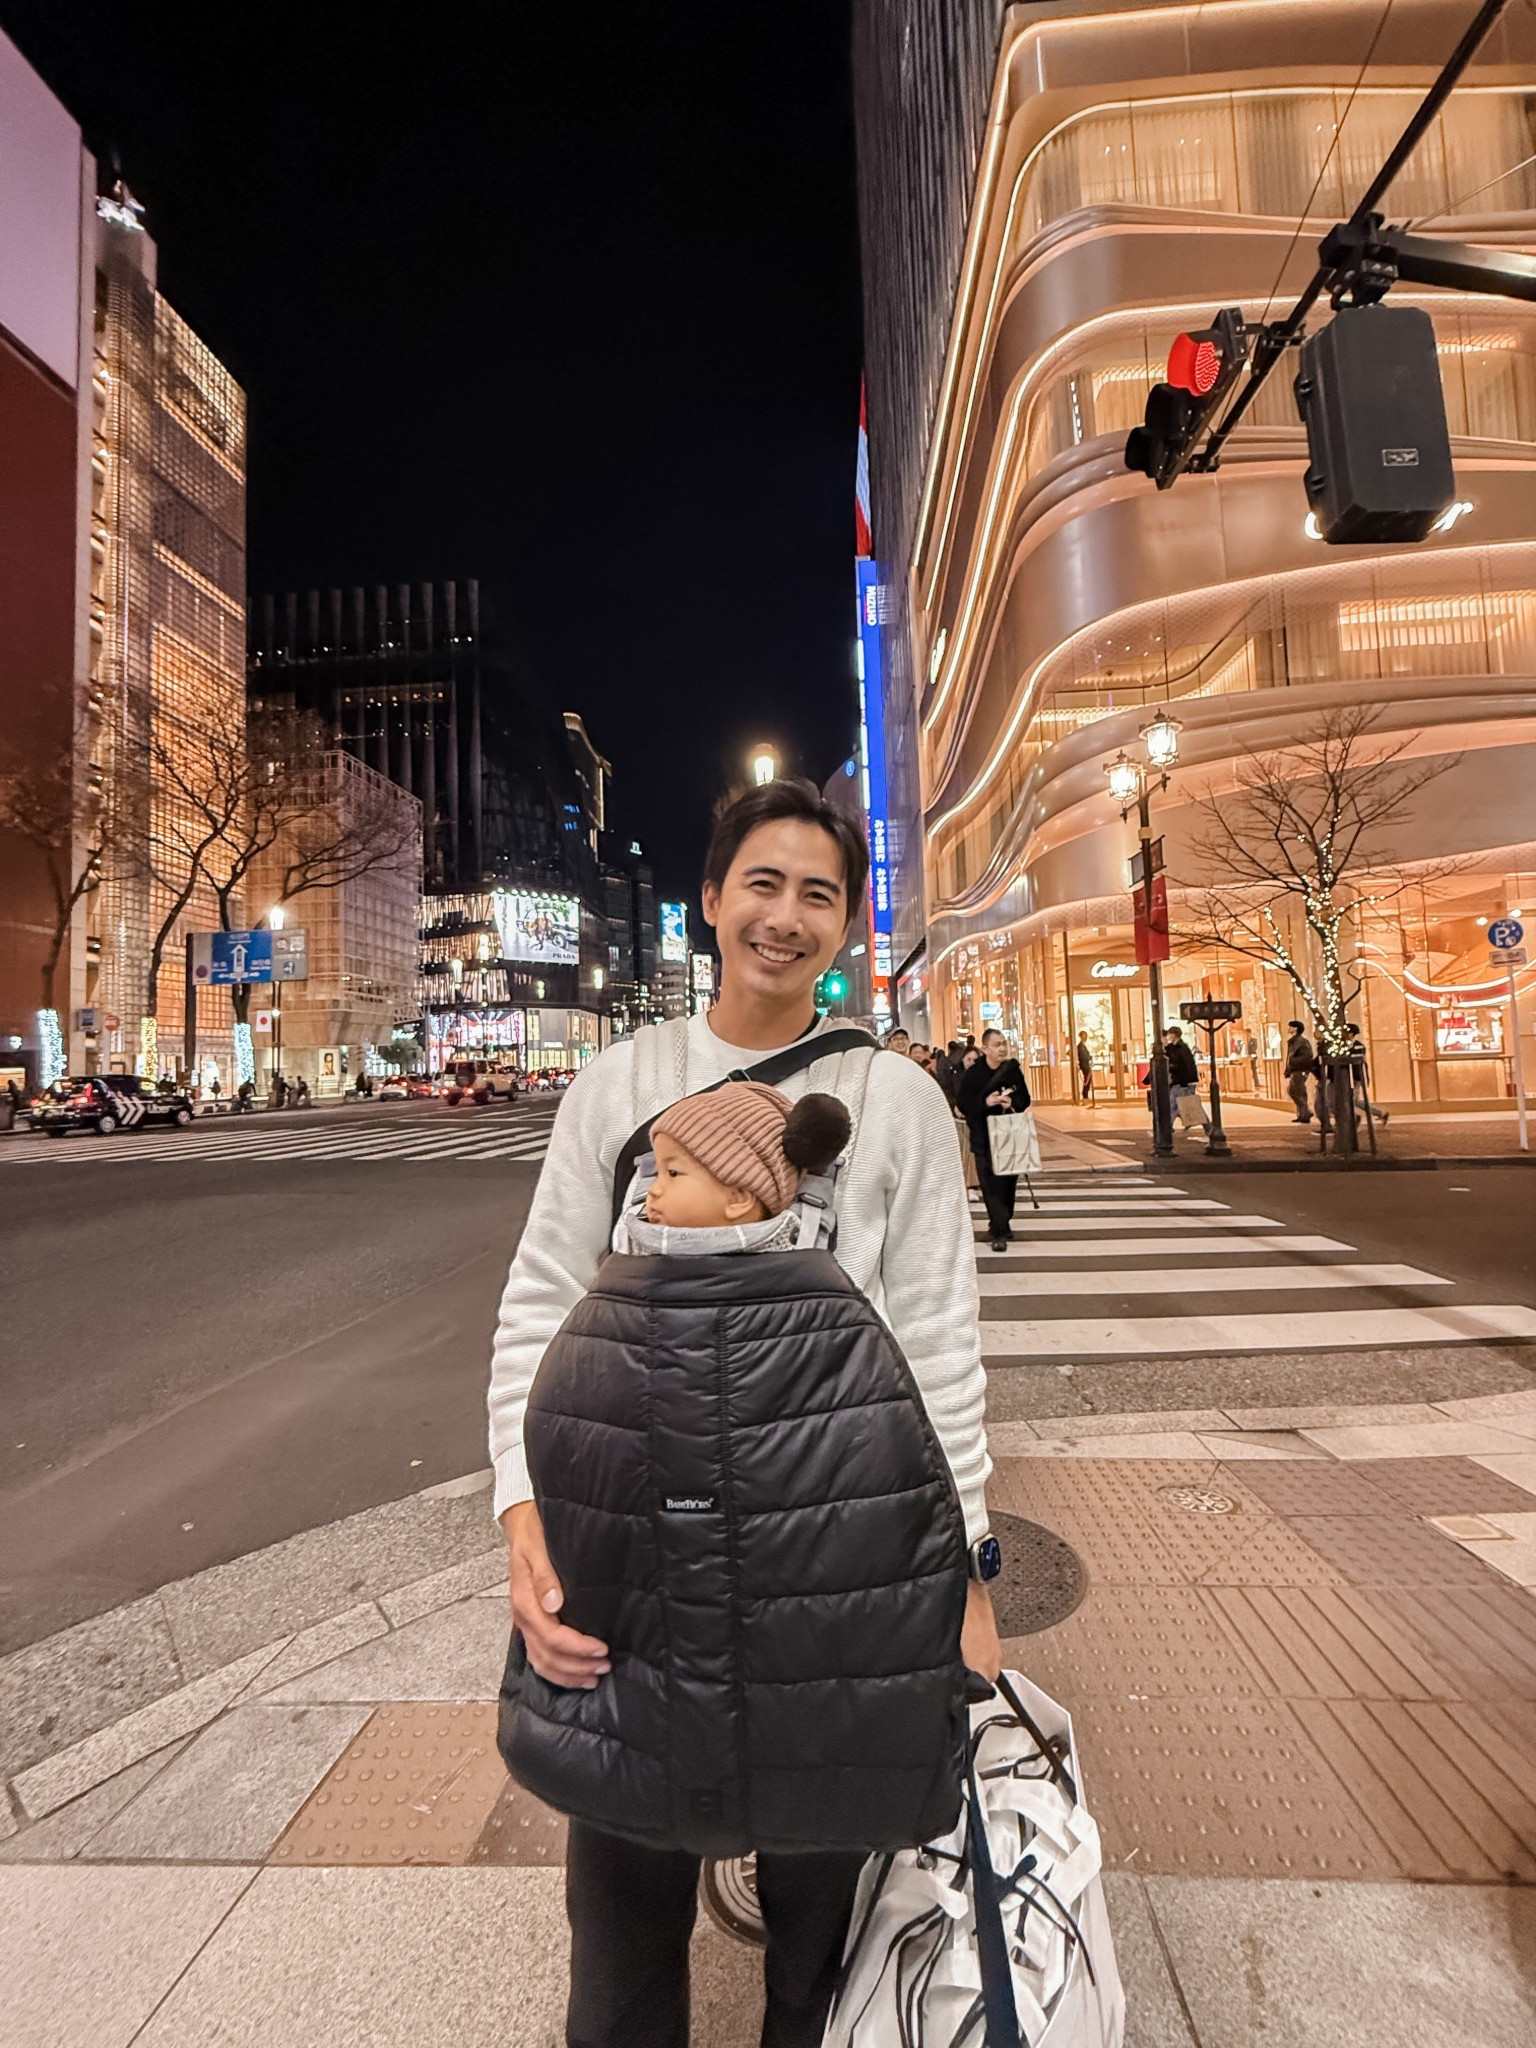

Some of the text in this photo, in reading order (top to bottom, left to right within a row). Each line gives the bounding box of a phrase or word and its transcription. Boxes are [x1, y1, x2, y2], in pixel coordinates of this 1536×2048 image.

[866, 585, 877, 626] MIZUHO
[552, 952, 576, 960] PRADA
[1091, 960, 1140, 978] Cartier
